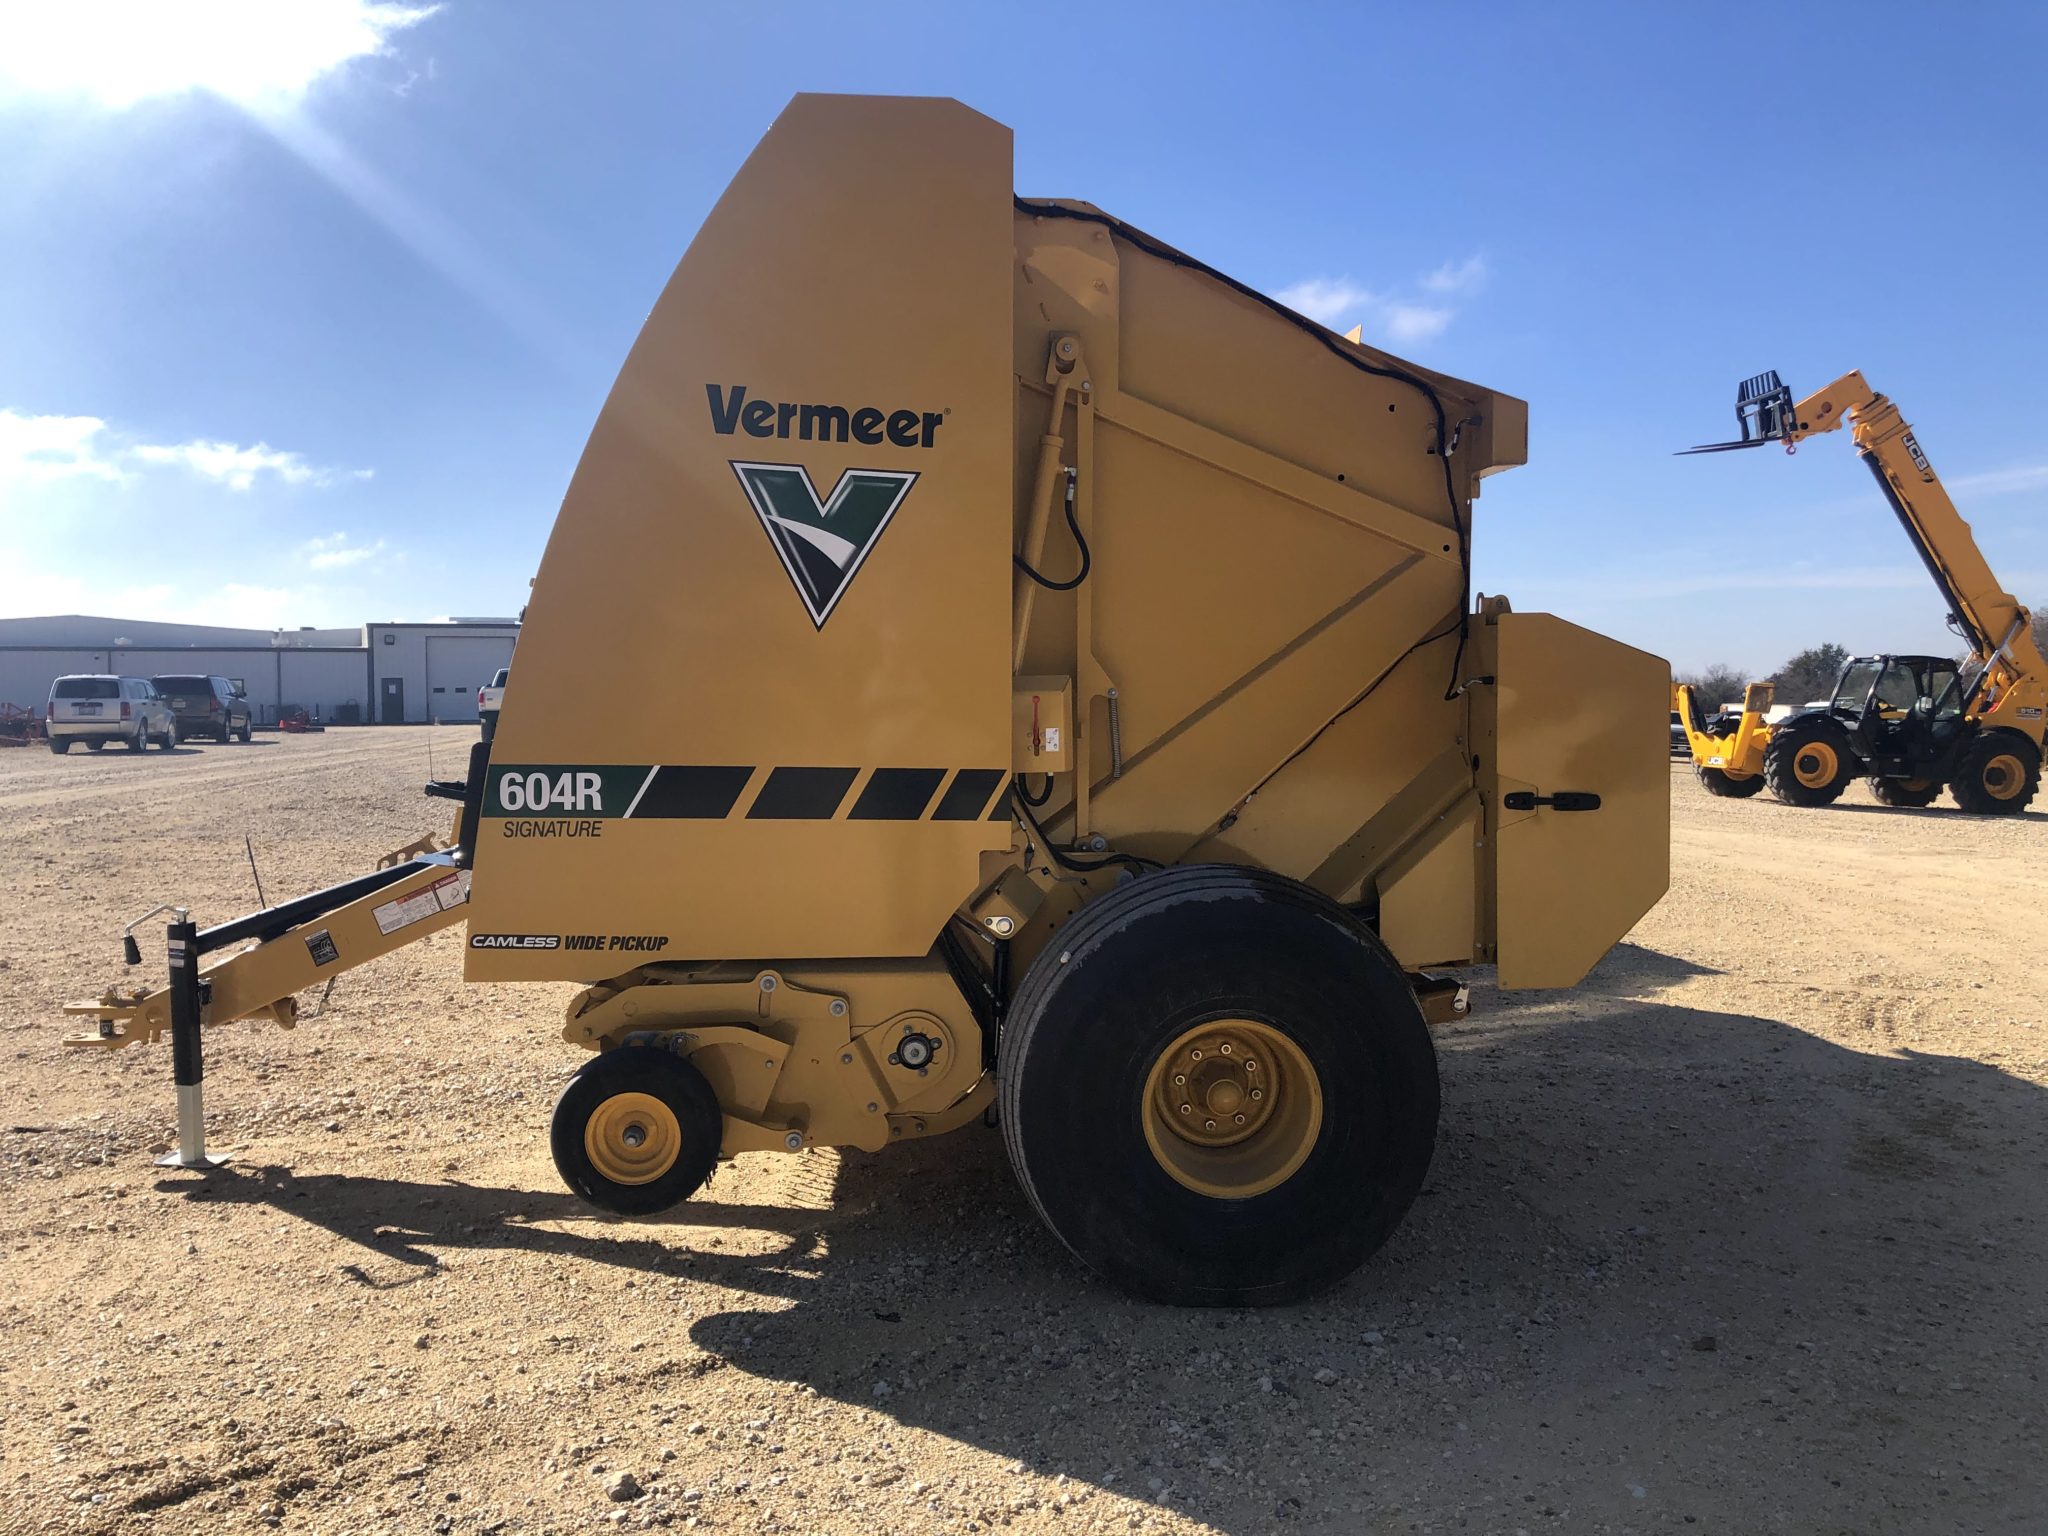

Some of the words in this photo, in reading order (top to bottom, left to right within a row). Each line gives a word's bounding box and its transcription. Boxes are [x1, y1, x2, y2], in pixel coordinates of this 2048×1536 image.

[705, 383, 943, 448] Vermeer
[1902, 435, 1929, 471] JCB
[500, 772, 603, 811] 604R
[503, 820, 603, 838] SIGNATURE
[472, 936, 558, 948] CAMLESS
[564, 935, 607, 951] WIDE
[608, 936, 669, 951] PICKUP
